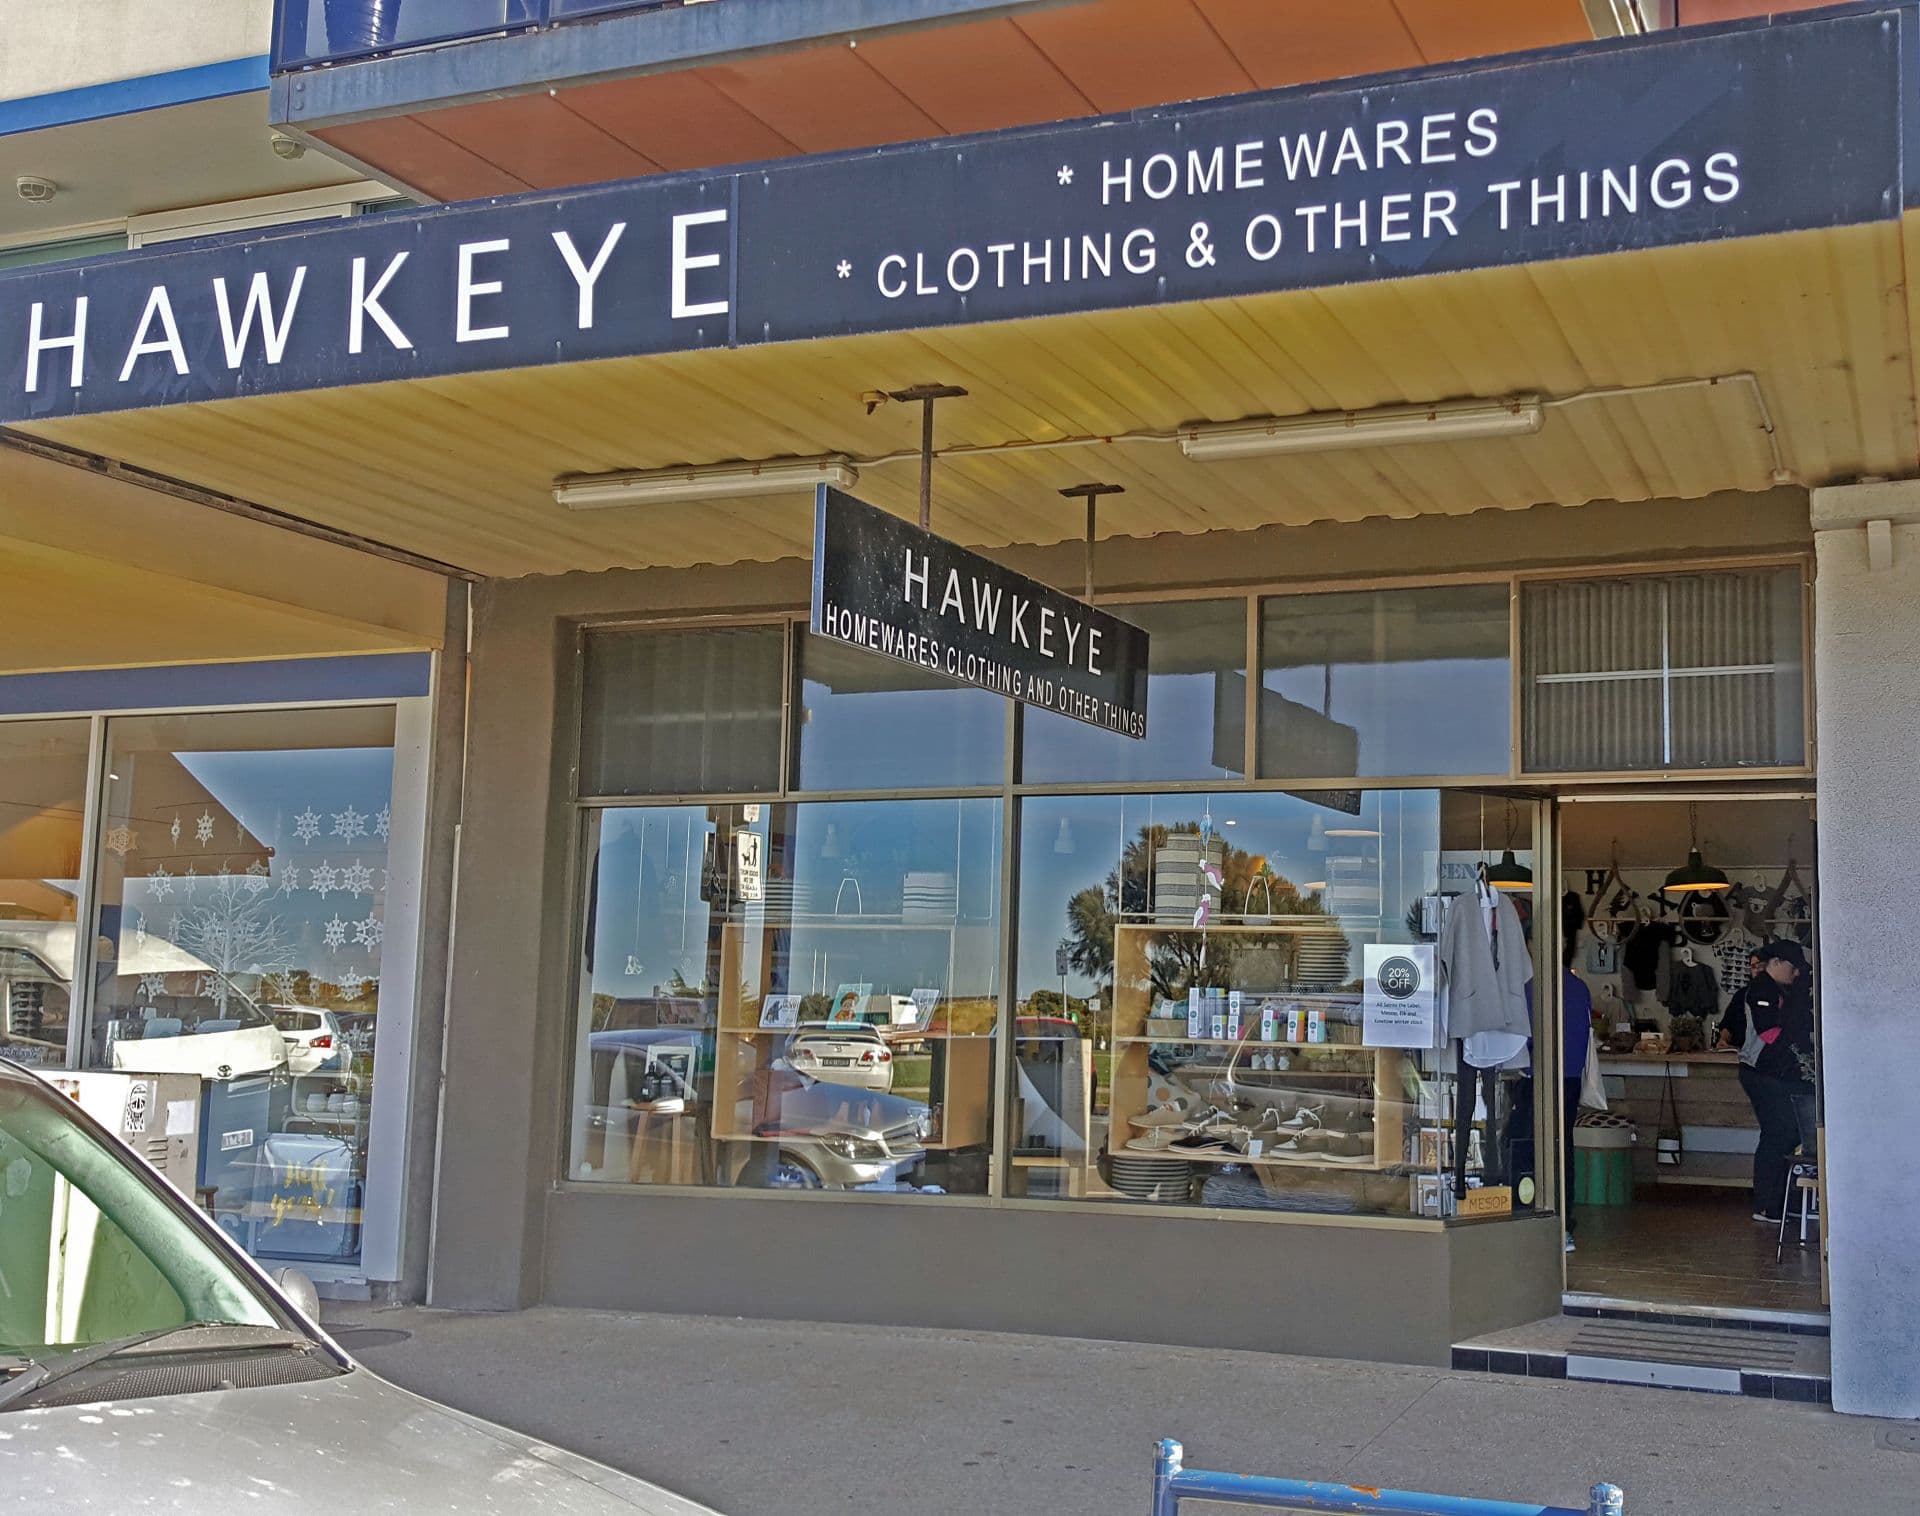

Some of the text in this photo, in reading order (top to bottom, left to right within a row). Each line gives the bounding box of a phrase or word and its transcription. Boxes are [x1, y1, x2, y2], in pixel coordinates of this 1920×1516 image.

[1102, 108, 1498, 206] HOMEWARES
[877, 228, 1157, 299] CLOTHING
[1185, 221, 1216, 268] &
[1245, 190, 1458, 262] OTHER
[1487, 152, 1740, 231] THINGS
[25, 209, 730, 393] HAWKEYE
[904, 548, 1103, 676] HAWKEYE
[826, 603, 1144, 736] HOMEWARES CLOTHING AND OTHER THINGS
[1388, 967, 1410, 978] 20%
[1388, 977, 1410, 989] OFF
[1469, 1195, 1508, 1211] MESOP
